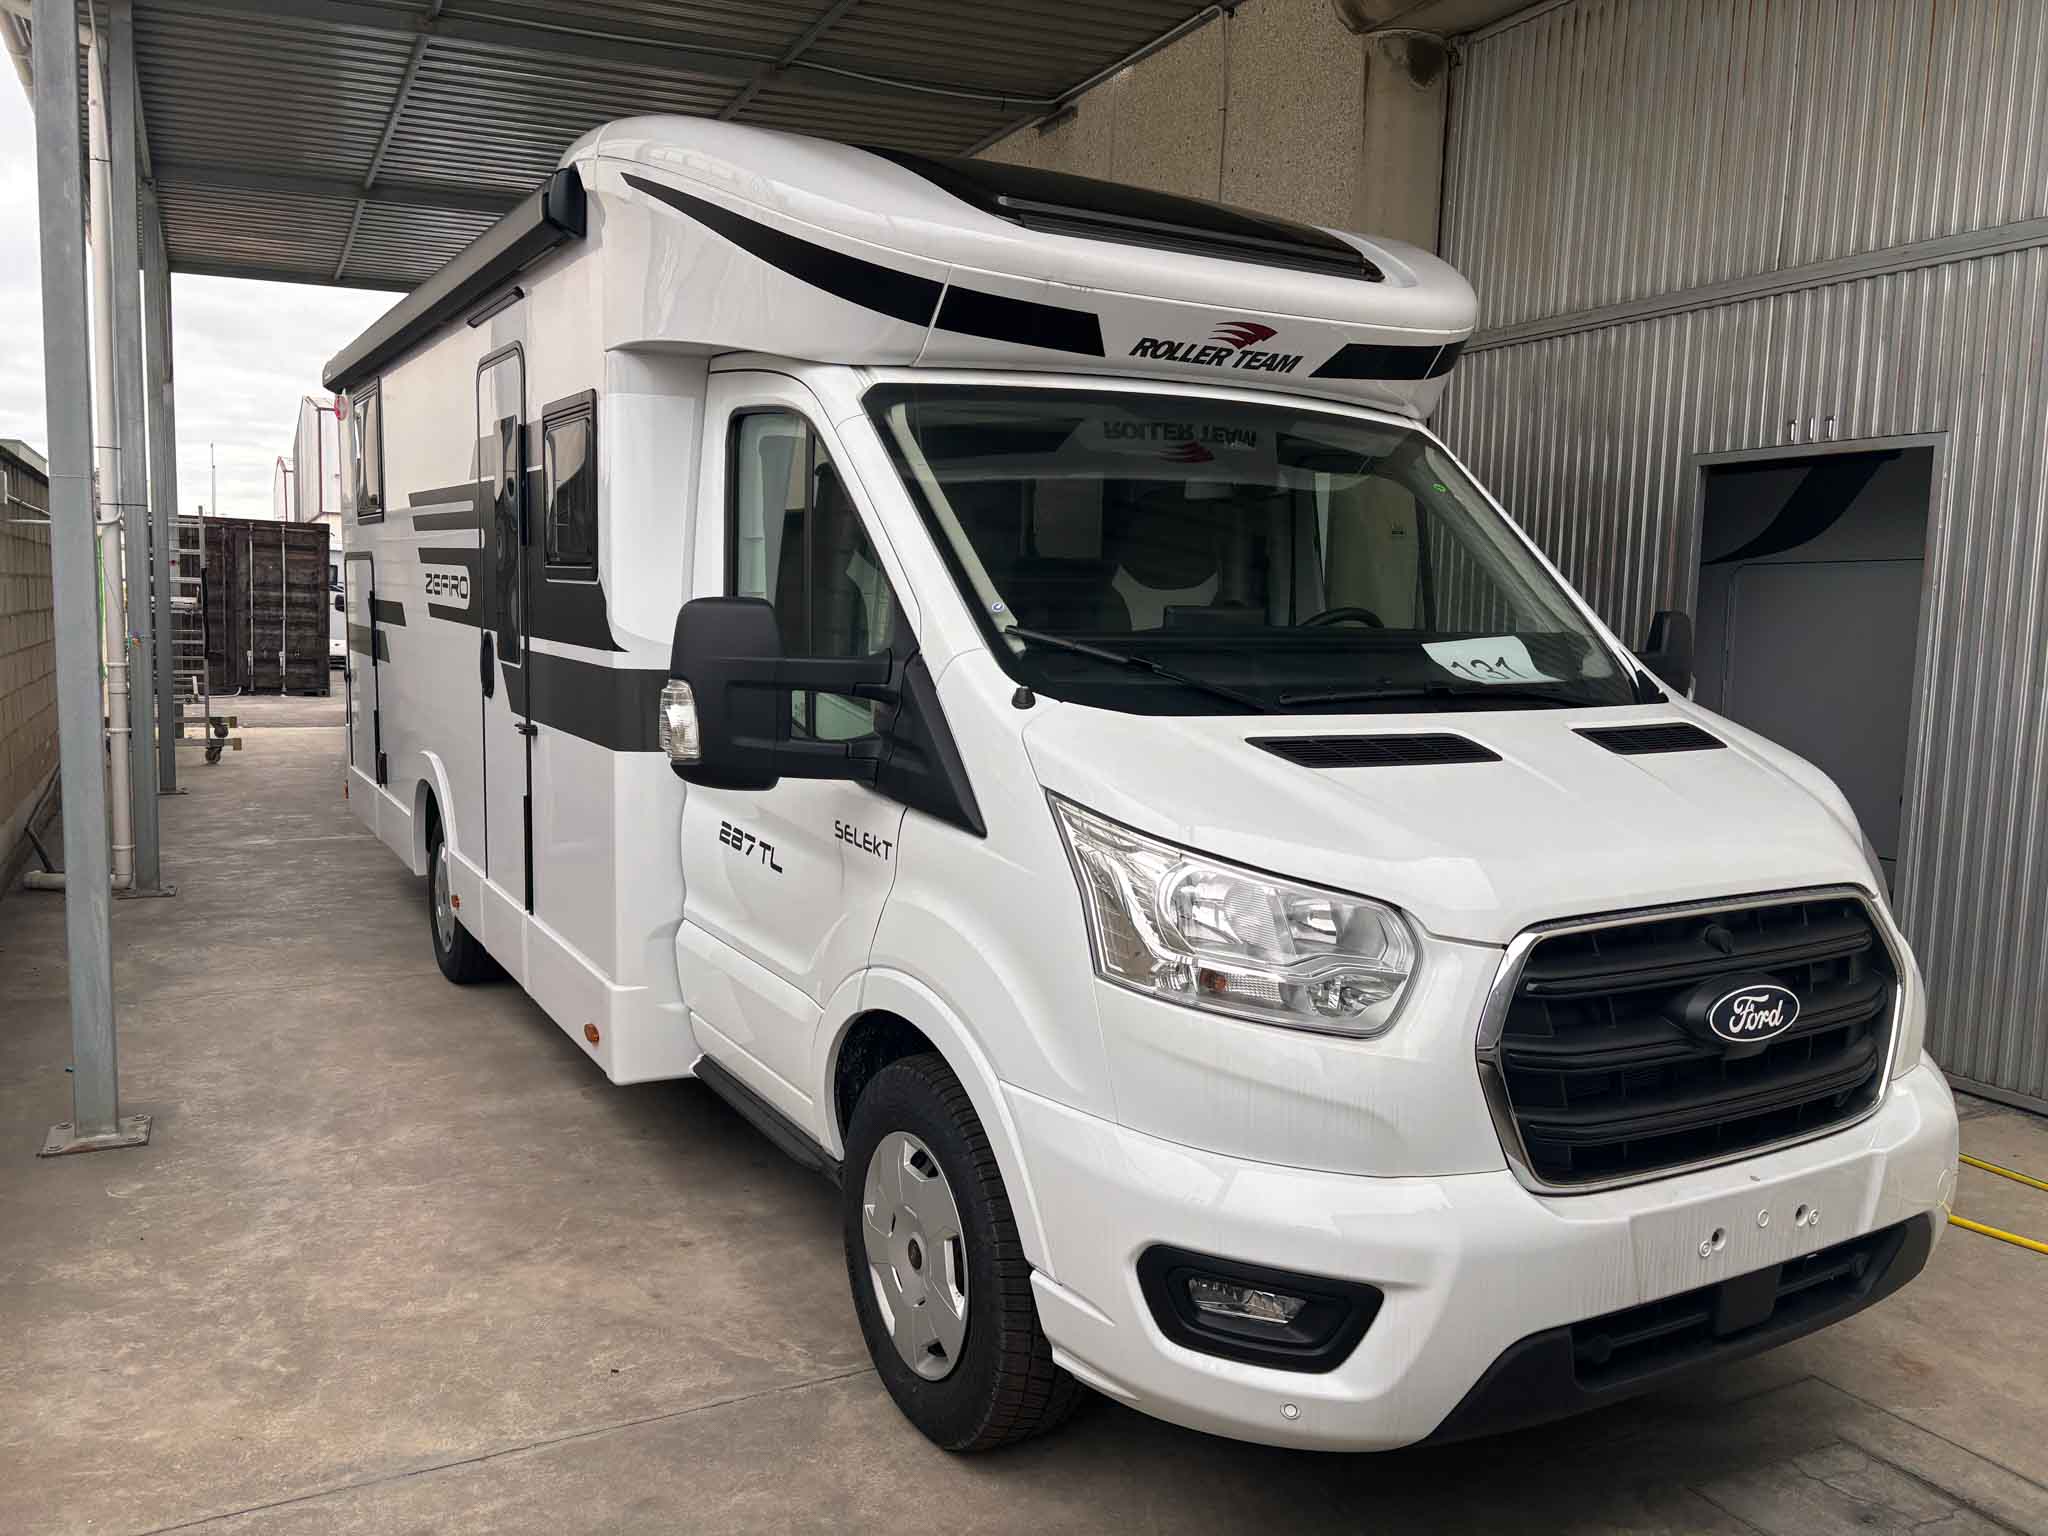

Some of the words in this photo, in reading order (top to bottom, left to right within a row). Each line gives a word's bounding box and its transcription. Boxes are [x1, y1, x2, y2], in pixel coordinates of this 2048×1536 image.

[1129, 337, 1234, 366] ROLLER
[1232, 350, 1303, 373] TEAM
[425, 573, 468, 599] ZEFIRO
[759, 840, 783, 873] TL
[835, 820, 893, 860] SELEKT
[1729, 994, 1784, 1033] Ford
